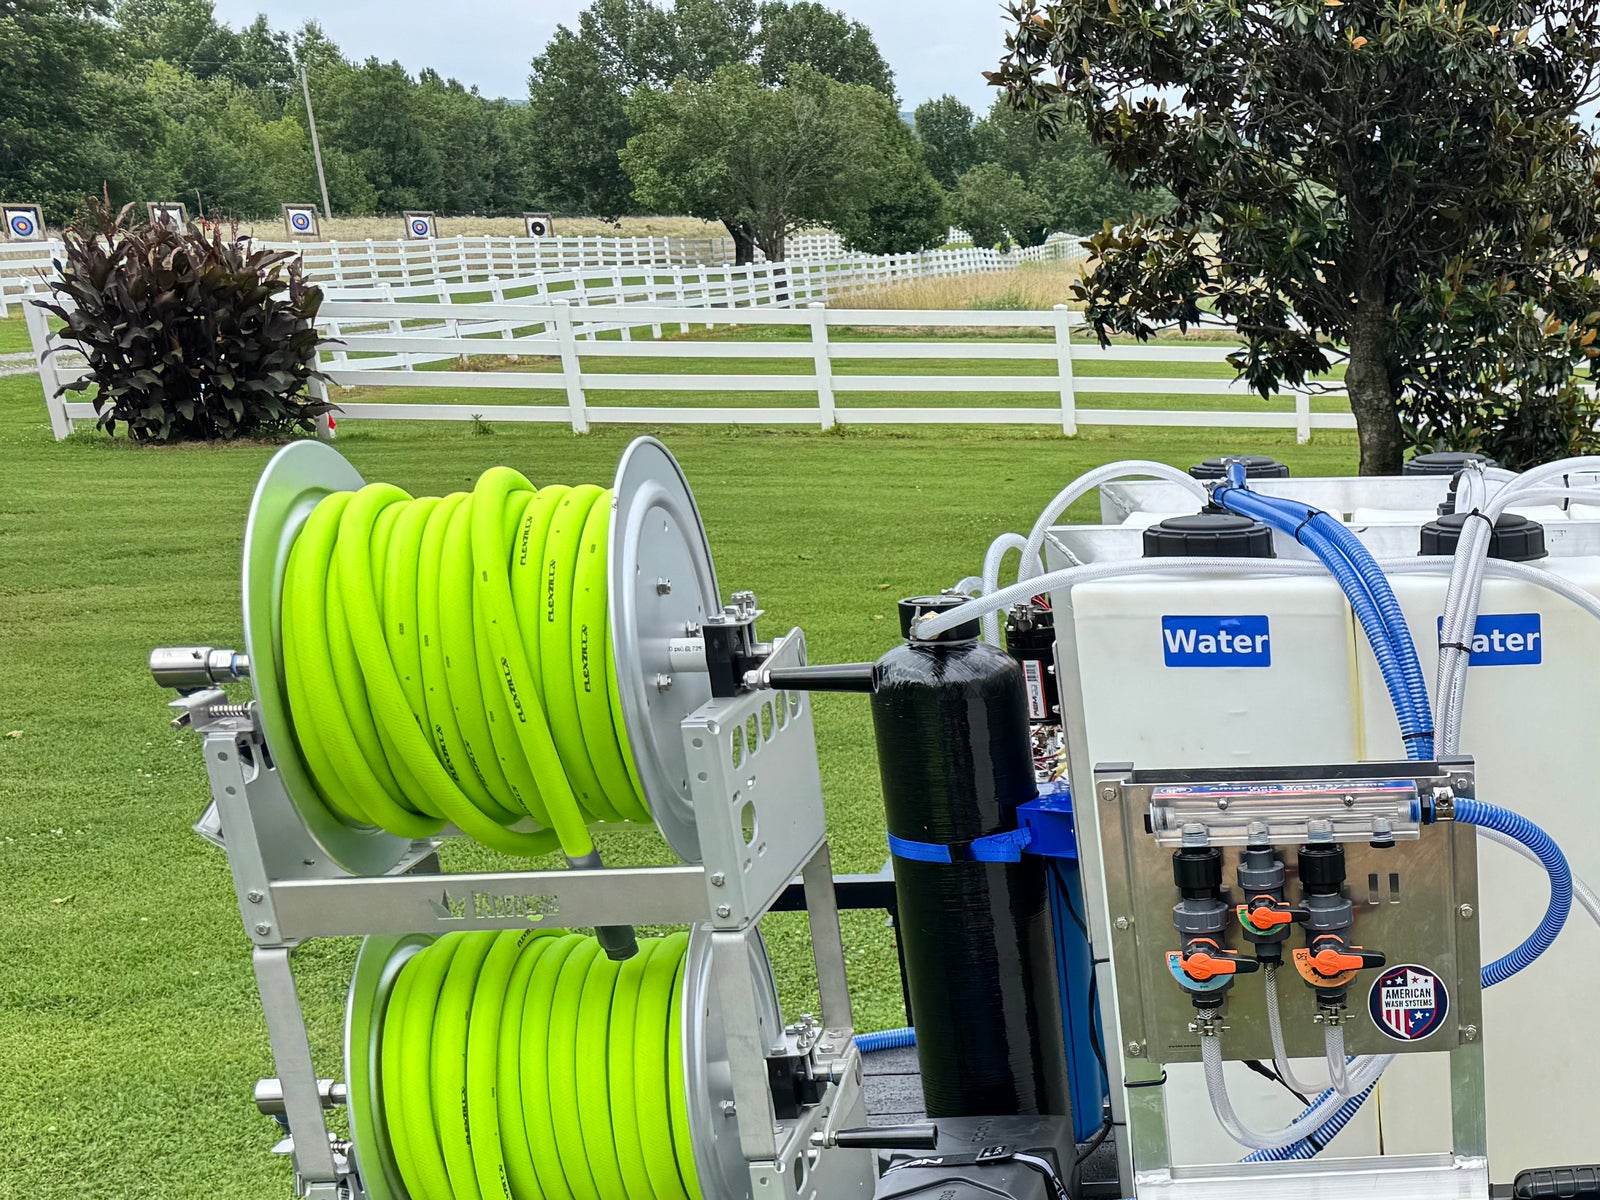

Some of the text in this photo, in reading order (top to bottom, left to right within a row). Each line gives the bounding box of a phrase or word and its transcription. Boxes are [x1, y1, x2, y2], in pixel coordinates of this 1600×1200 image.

[519, 515, 533, 566] FLEXZILLA
[547, 559, 557, 622] FLEXZILLA
[581, 624, 592, 692] FLEXZILLA
[1163, 629, 1269, 654] Water
[1472, 630, 1539, 652] ater
[500, 656, 527, 723] FLEXZILLA
[1384, 999, 1433, 1008] WASH SYSTEMS
[1385, 988, 1432, 1000] AMERICAN
